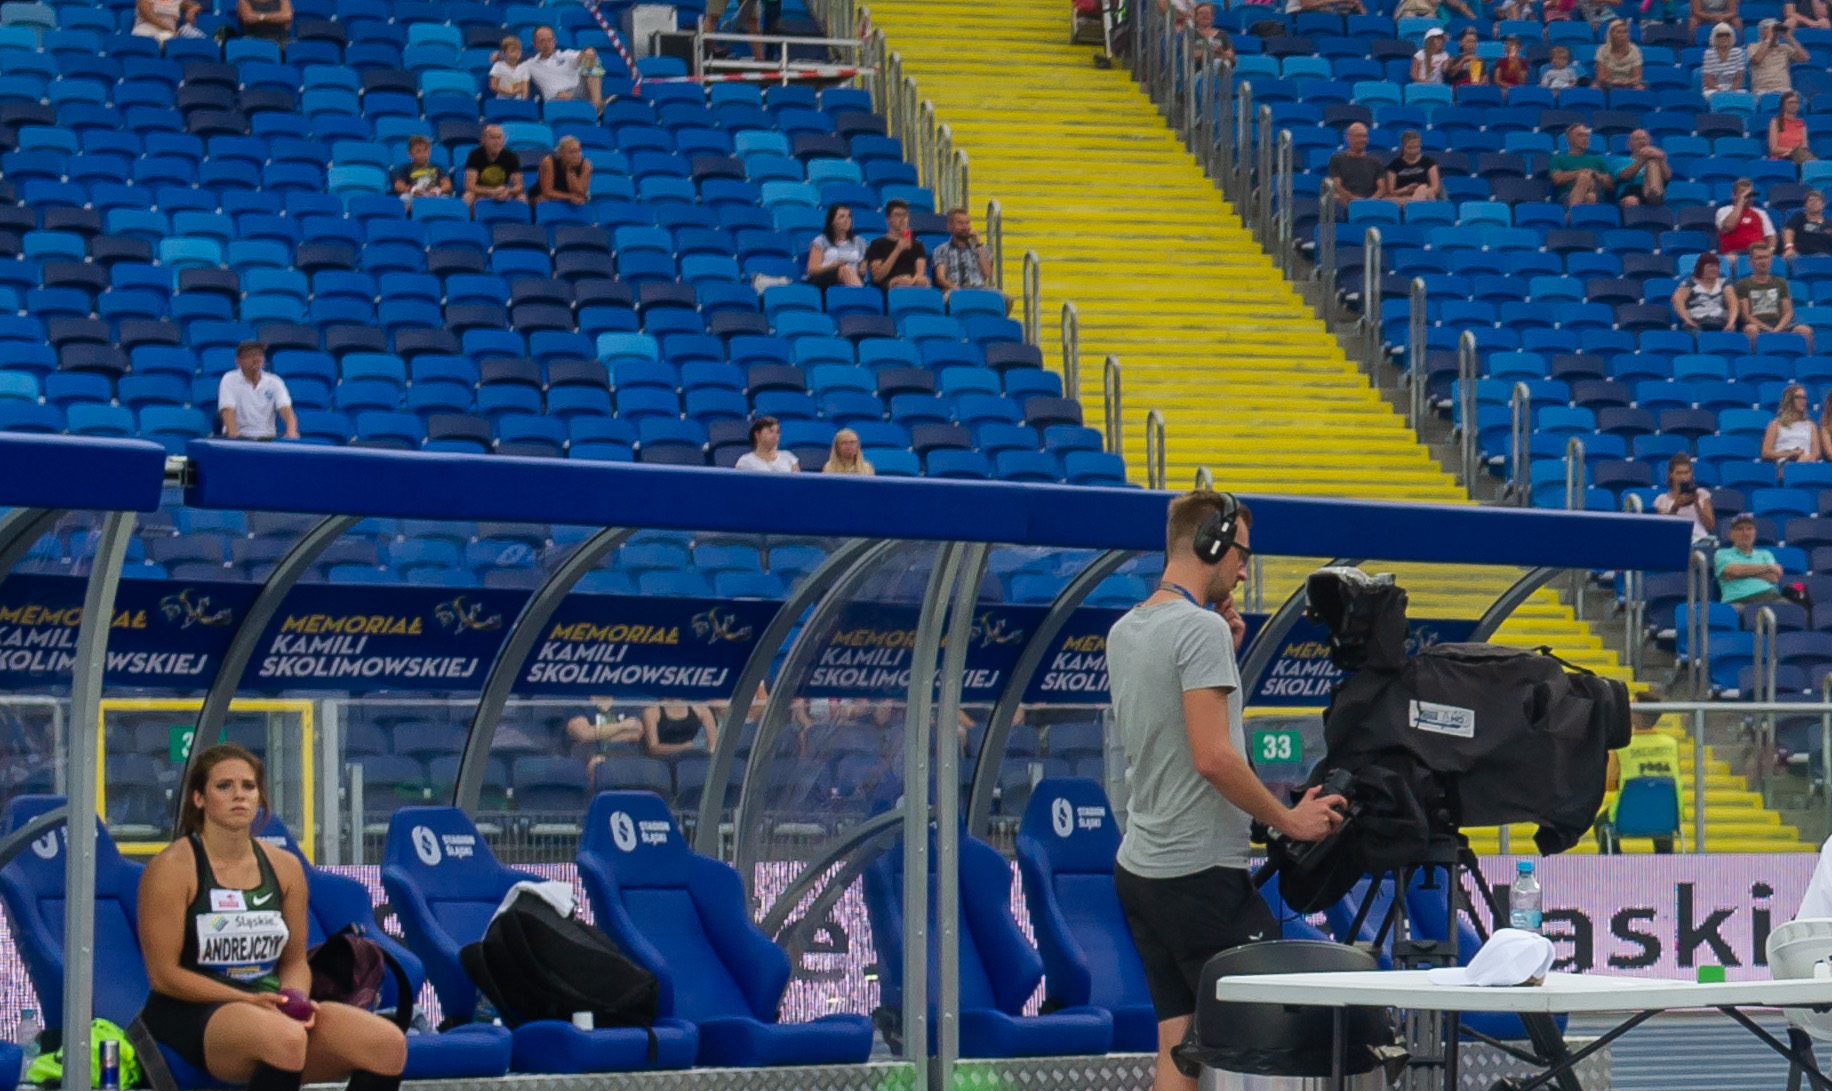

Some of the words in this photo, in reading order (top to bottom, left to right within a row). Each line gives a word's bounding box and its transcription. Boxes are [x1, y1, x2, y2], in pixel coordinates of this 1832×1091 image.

[0, 605, 147, 629] MEMOAŁ
[280, 614, 422, 635] MEMORIAŁ
[269, 634, 368, 655] KAMILI
[549, 622, 679, 645] MEMORIAŁ
[537, 641, 629, 663] KAMILI
[819, 647, 905, 667] KAMILI
[259, 656, 479, 678] SKOLIMOWSKIEJ
[526, 663, 730, 687] SKOLIMOWSKIEJ
[1262, 734, 1292, 761] 33
